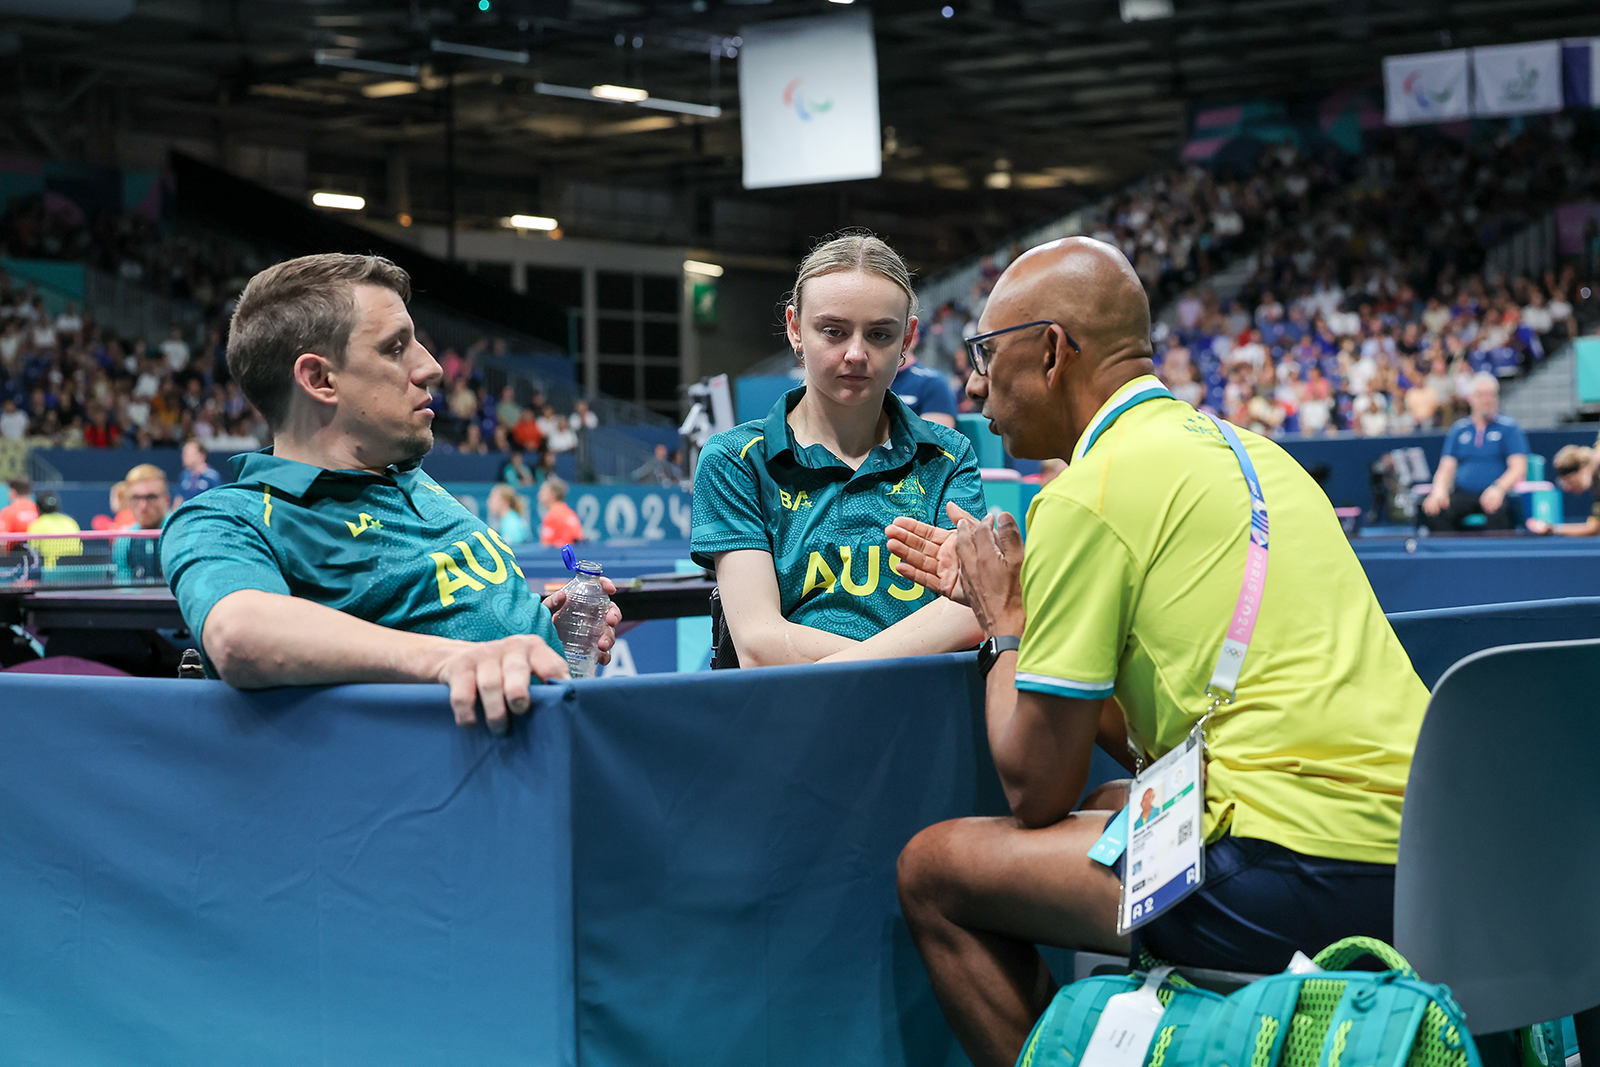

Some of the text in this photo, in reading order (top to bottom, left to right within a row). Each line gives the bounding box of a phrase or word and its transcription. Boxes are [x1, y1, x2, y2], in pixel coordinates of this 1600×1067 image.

[576, 493, 692, 541] 2024
[800, 545, 925, 601] AUS
[1234, 550, 1263, 636] PARIS 2024
